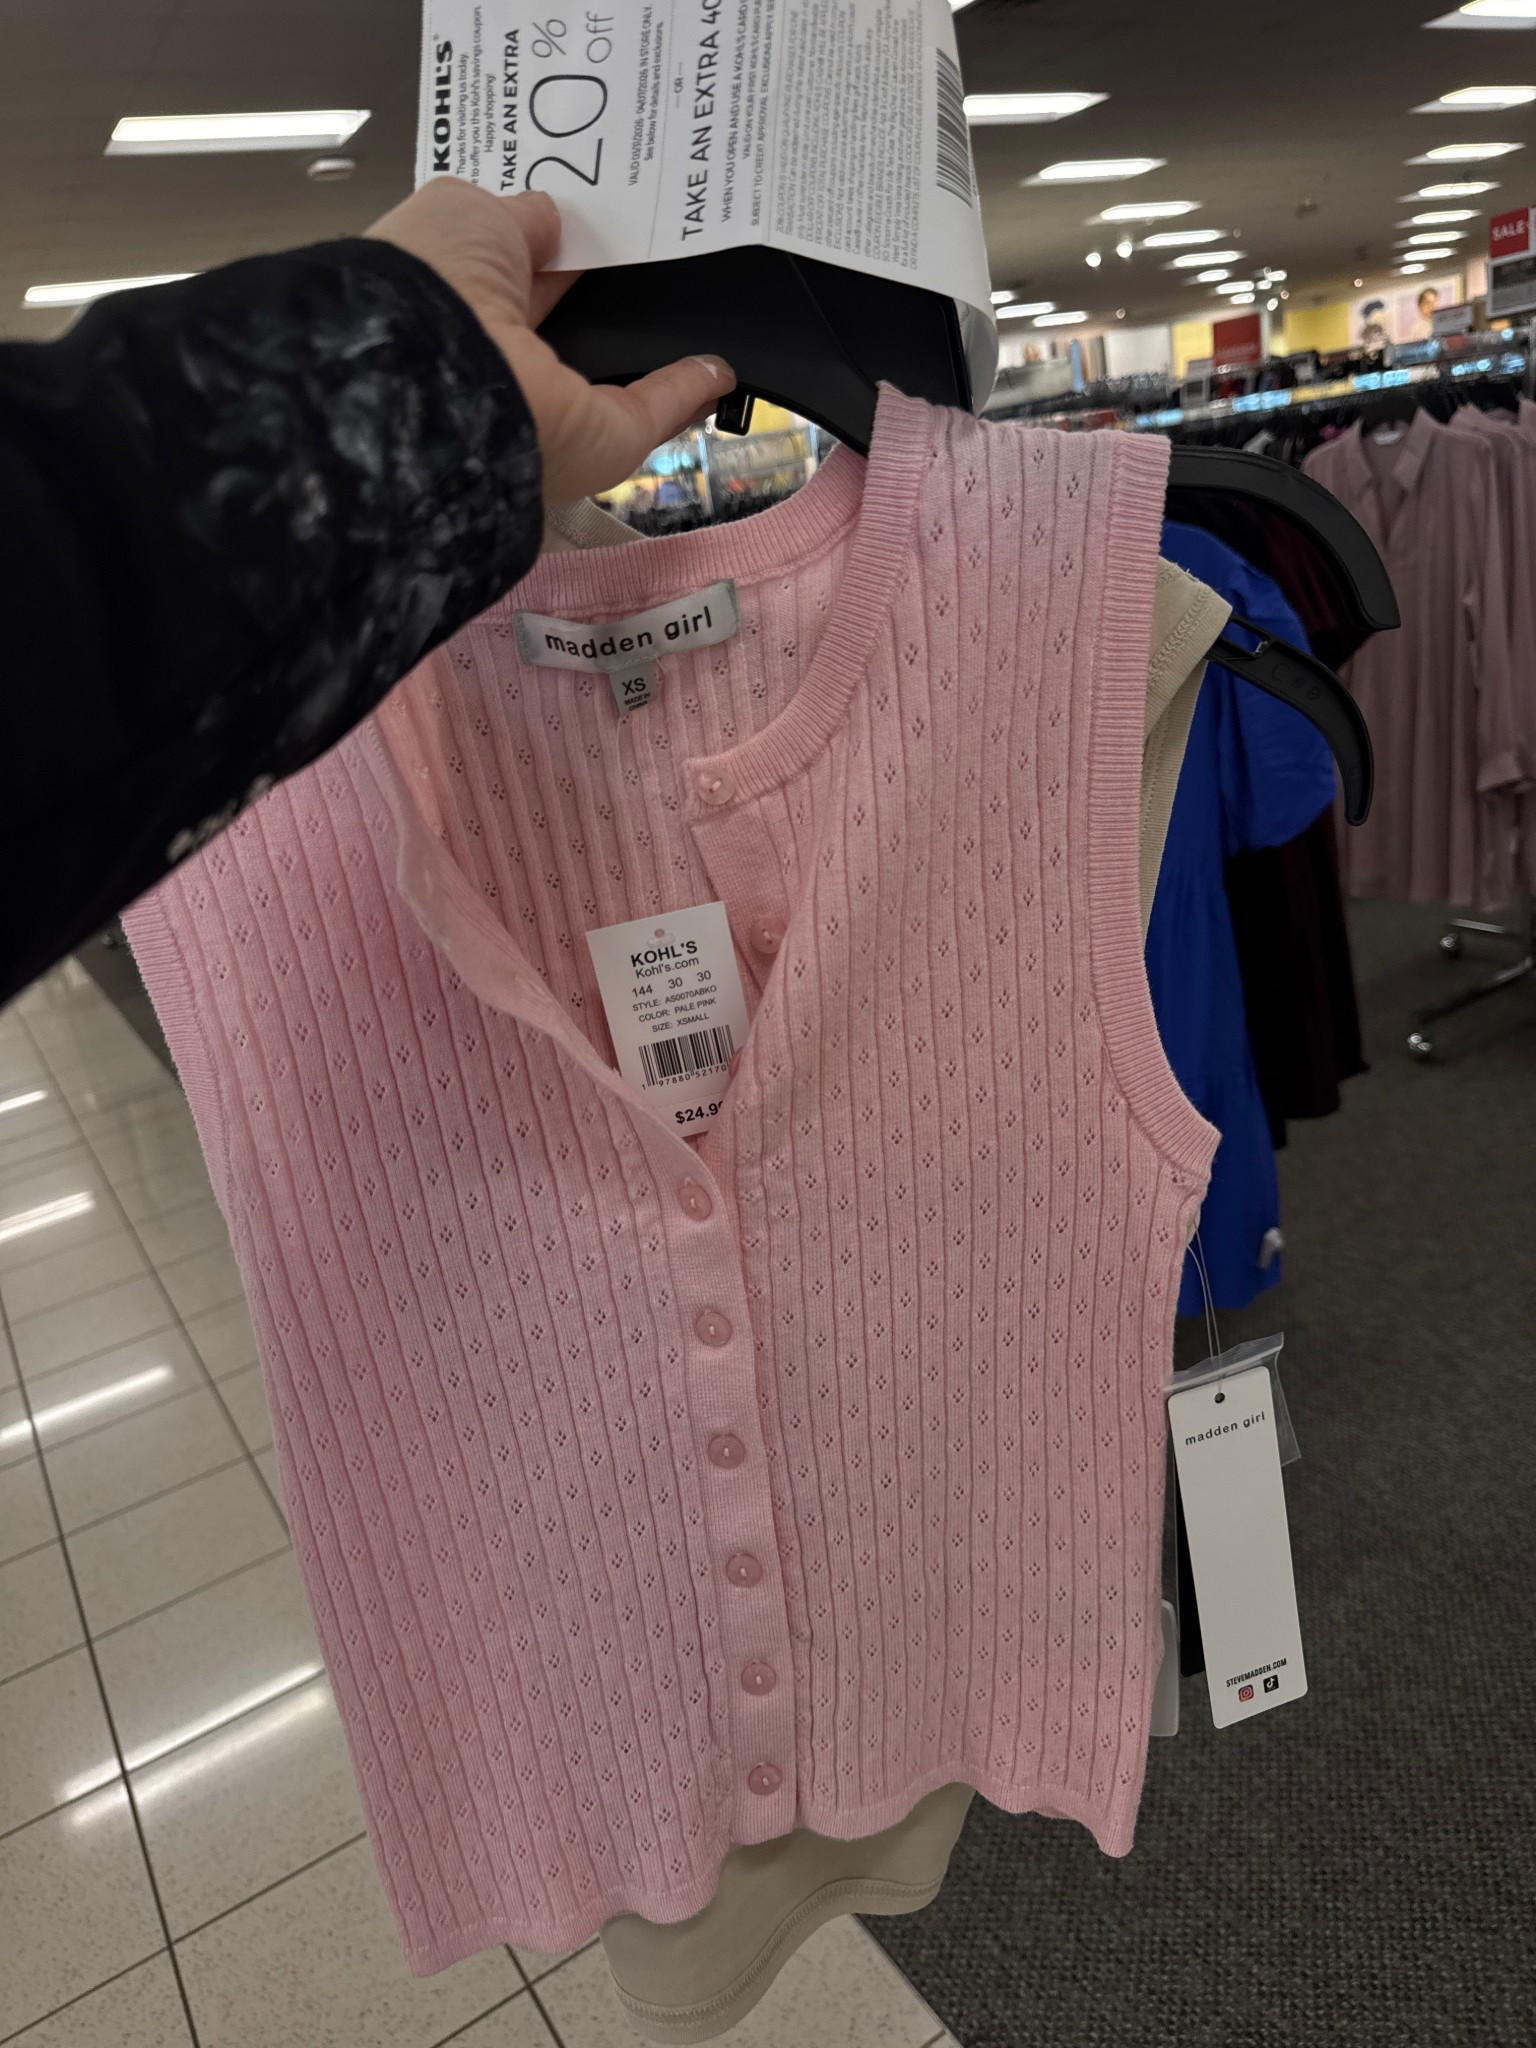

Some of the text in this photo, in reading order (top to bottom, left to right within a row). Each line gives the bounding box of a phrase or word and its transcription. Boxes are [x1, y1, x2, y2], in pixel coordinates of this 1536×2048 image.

[473, 6, 483, 43] coupon.
[736, 5, 749, 34] CARD
[472, 45, 483, 78] savings
[651, 65, 661, 80] and
[693, 30, 720, 118] EXTRA
[471, 79, 481, 106] Kohl's
[649, 81, 660, 107] details
[731, 82, 742, 104] USE
[745, 94, 755, 117] YOUR
[433, 41, 453, 171] KOHL'S
[456, 53, 469, 175] Thanks for visiting us today.
[472, 108, 480, 124] this
[484, 73, 496, 153] Happy shopping!
[501, 29, 519, 191] TAKE AN EXTRA
[628, 161, 640, 186] VALID
[640, 30, 650, 56] STORE
[648, 109, 657, 120] for
[729, 104, 740, 128] AND
[473, 126, 483, 144] you
[646, 120, 657, 145] below
[690, 125, 713, 162] AN
[726, 131, 738, 160] OPEN
[742, 132, 753, 159] VALID
[470, 146, 480, 166] offer
[645, 147, 654, 161] See
[755, 143, 765, 174] CREDIT
[471, 168, 479, 177] to
[724, 162, 736, 185] YOU
[753, 174, 762, 186] TO
[682, 170, 709, 241] TAKE
[721, 187, 734, 222] WHEN
[751, 188, 761, 226] SUBJECT
[1492, 220, 1525, 241] SALE
[545, 605, 712, 659] madden girl
[622, 678, 646, 696] XS
[624, 695, 643, 705] MADE
[630, 941, 698, 967] KOHL'S
[636, 957, 700, 979] Kohl's.com
[632, 970, 711, 998] 144 30 30
[632, 998, 661, 1012] STYLE:
[639, 997, 717, 1022] COLOR: PALE PINK
[652, 1013, 709, 1033] SIZE: XSMALL
[1185, 1411, 1266, 1446] madden girl
[1226, 1658, 1287, 1688] STEVEMADDEN.COM
